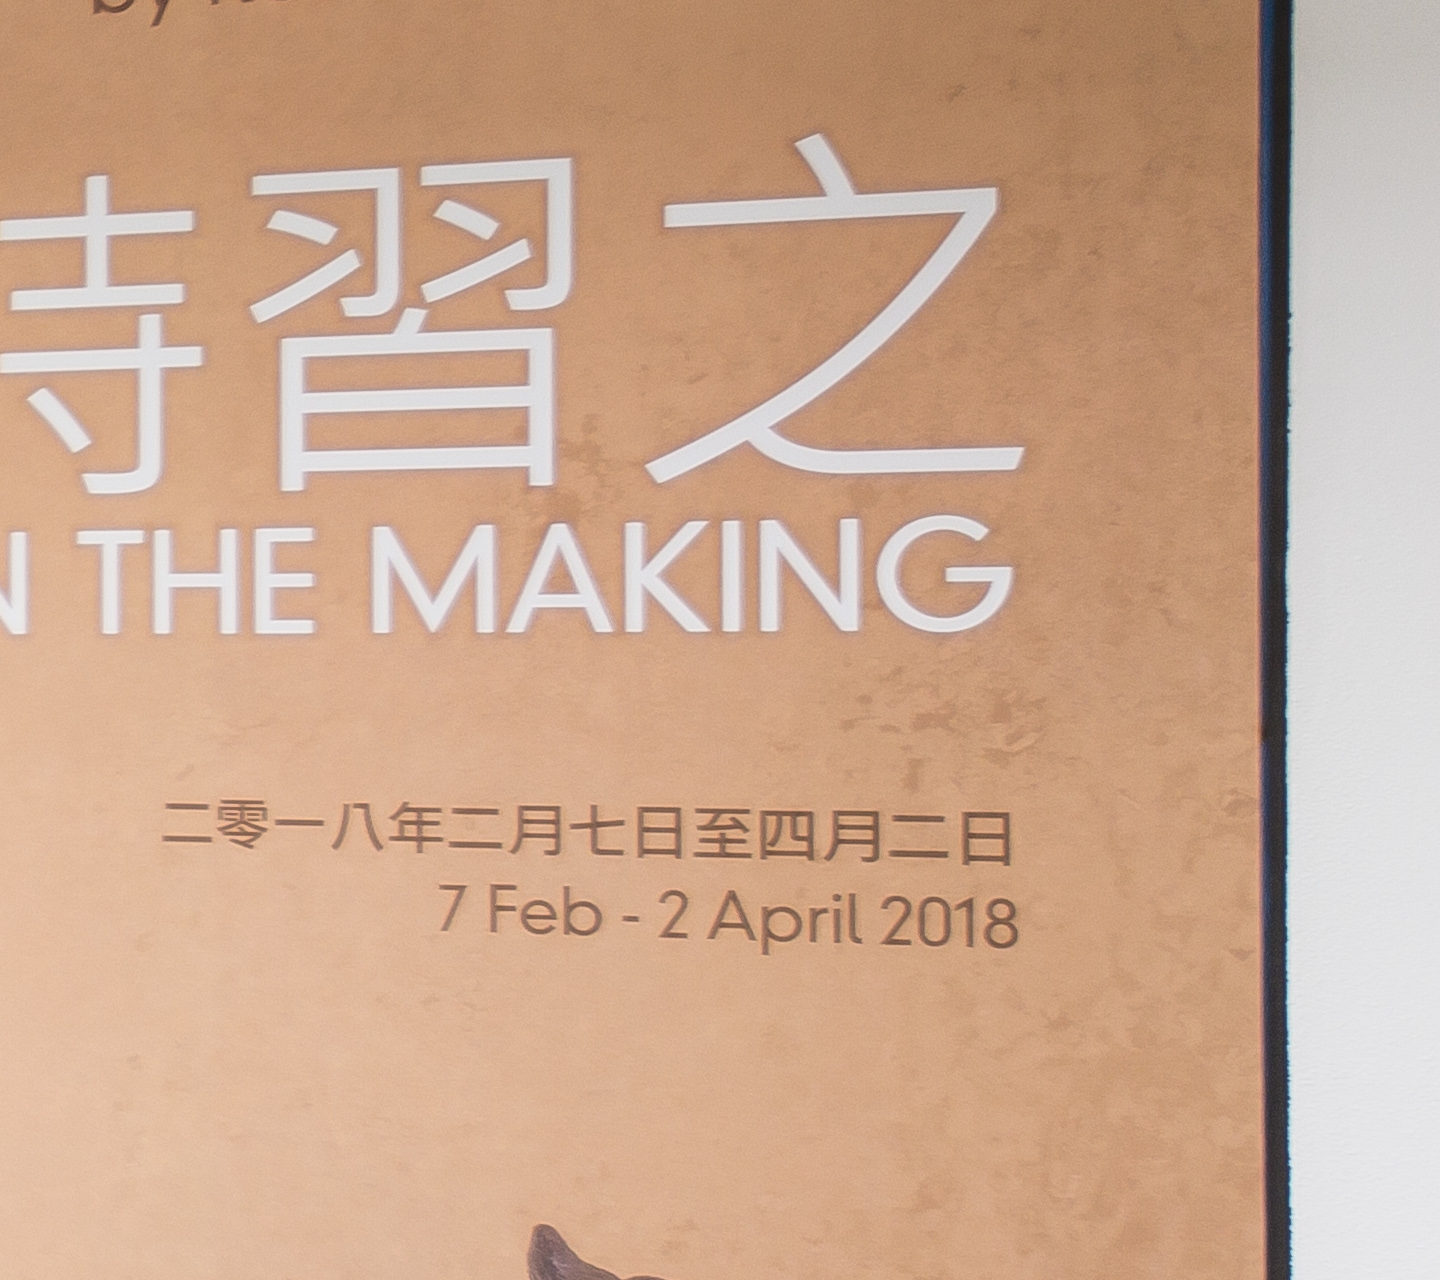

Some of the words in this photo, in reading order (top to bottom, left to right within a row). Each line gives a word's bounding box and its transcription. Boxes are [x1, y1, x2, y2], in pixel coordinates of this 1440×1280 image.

[77, 527, 315, 635] THE
[371, 514, 1013, 634] MAKING
[163, 799, 1012, 867] 二零一八年二月七日至四月二日
[439, 884, 468, 932] 7
[490, 884, 603, 937] Feb
[622, 915, 640, 923] -
[659, 889, 689, 939] 2
[707, 890, 863, 957] April
[881, 895, 1019, 949] 2018
